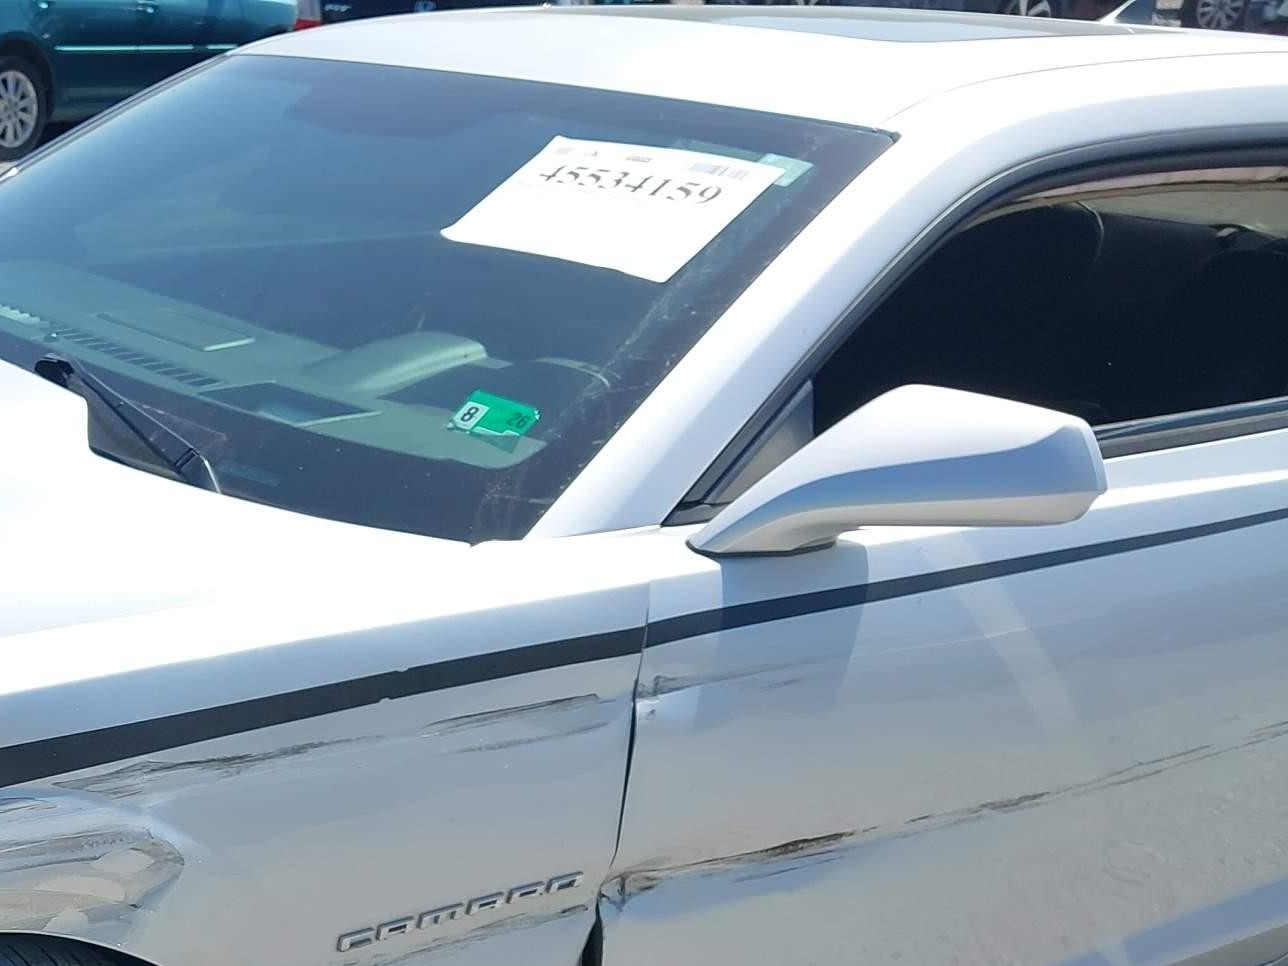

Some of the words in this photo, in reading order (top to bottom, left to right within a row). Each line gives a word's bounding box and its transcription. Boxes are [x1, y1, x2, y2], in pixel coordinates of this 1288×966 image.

[539, 165, 723, 205] 45534159
[460, 406, 480, 422] 8
[506, 412, 532, 429] 26
[336, 870, 585, 953] CAMARO
